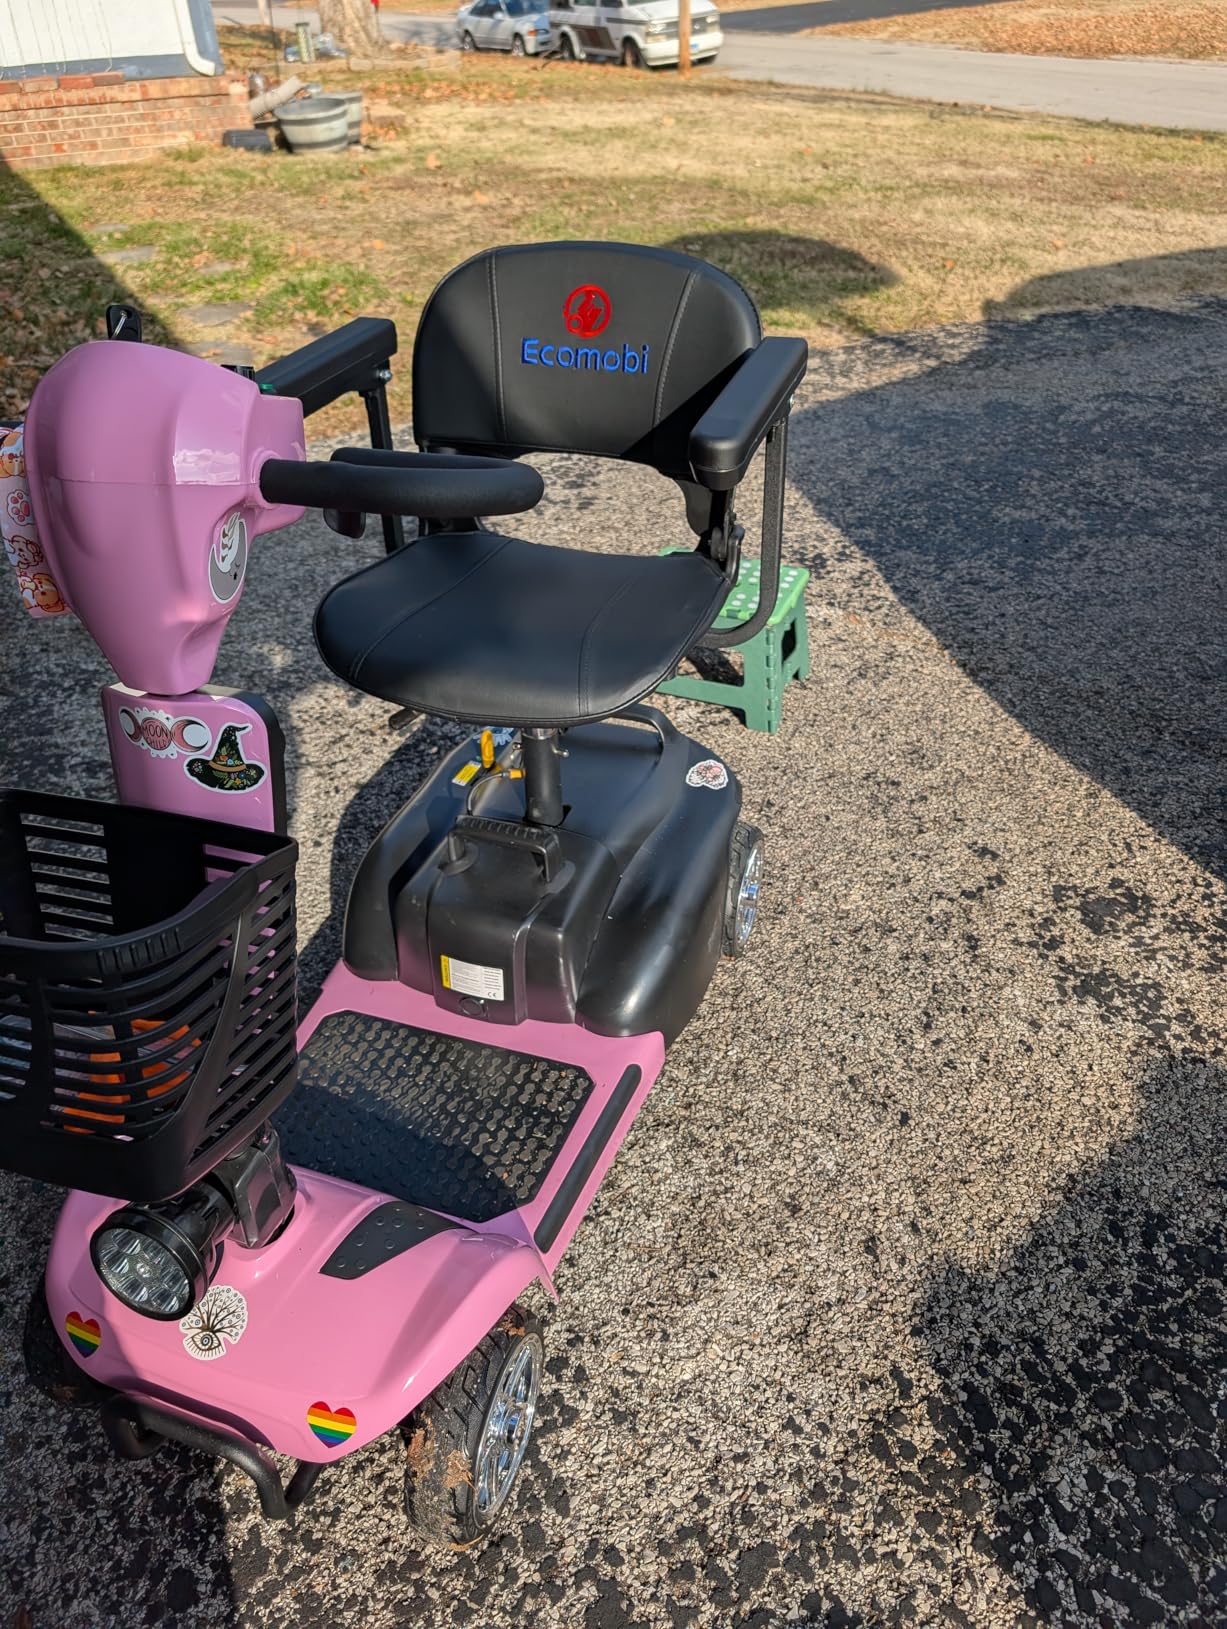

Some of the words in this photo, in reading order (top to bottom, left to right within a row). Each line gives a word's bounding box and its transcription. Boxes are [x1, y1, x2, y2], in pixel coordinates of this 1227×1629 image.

[521, 337, 649, 374] Ecomobi
[142, 724, 168, 738] MOON
[146, 737, 167, 749] CHILD
